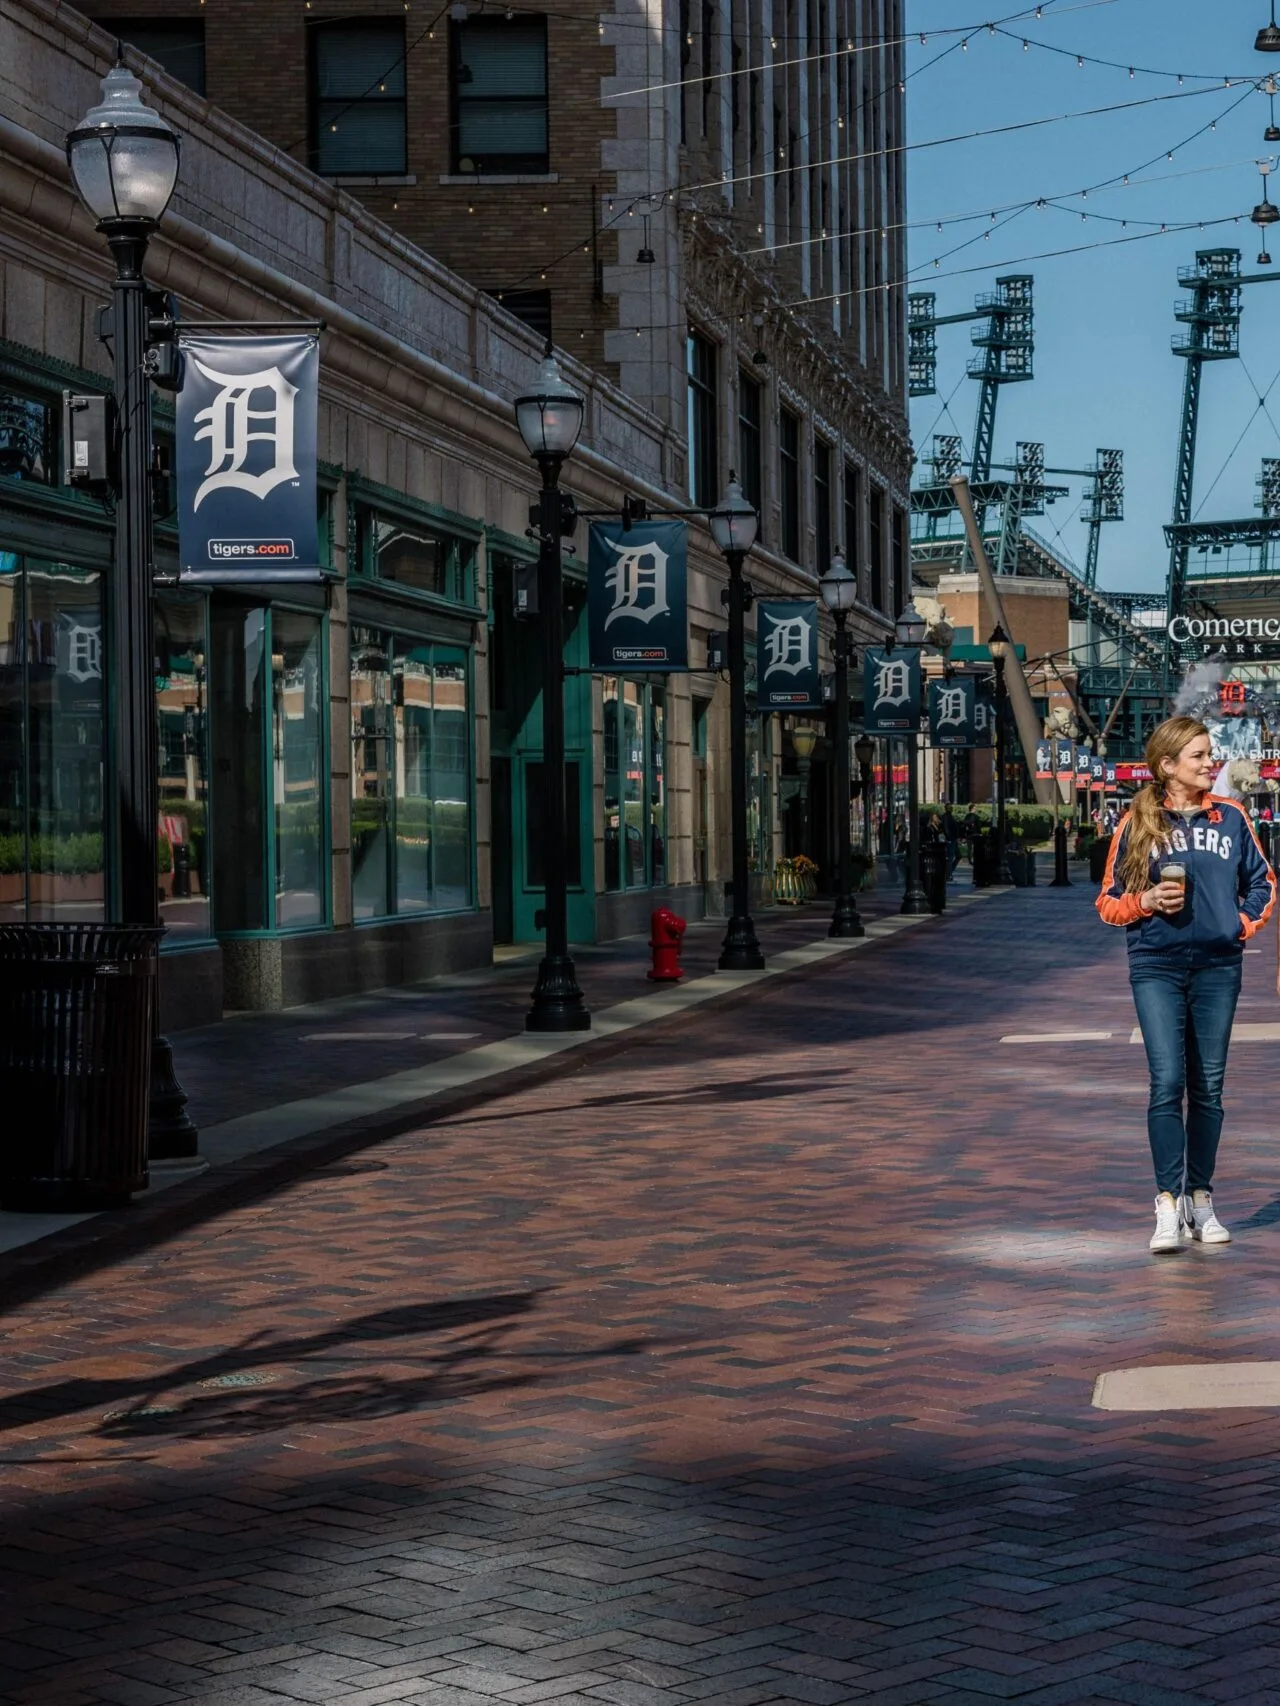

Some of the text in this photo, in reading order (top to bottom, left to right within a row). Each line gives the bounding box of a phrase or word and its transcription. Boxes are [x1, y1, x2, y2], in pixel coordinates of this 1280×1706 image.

[193, 359, 300, 514] D
[213, 543, 289, 557] tigers.com
[604, 537, 670, 632] D
[616, 649, 664, 659] tigers.com
[764, 611, 812, 682] D
[1203, 644, 1262, 653] PARK
[873, 657, 911, 711] D
[936, 685, 968, 730] D
